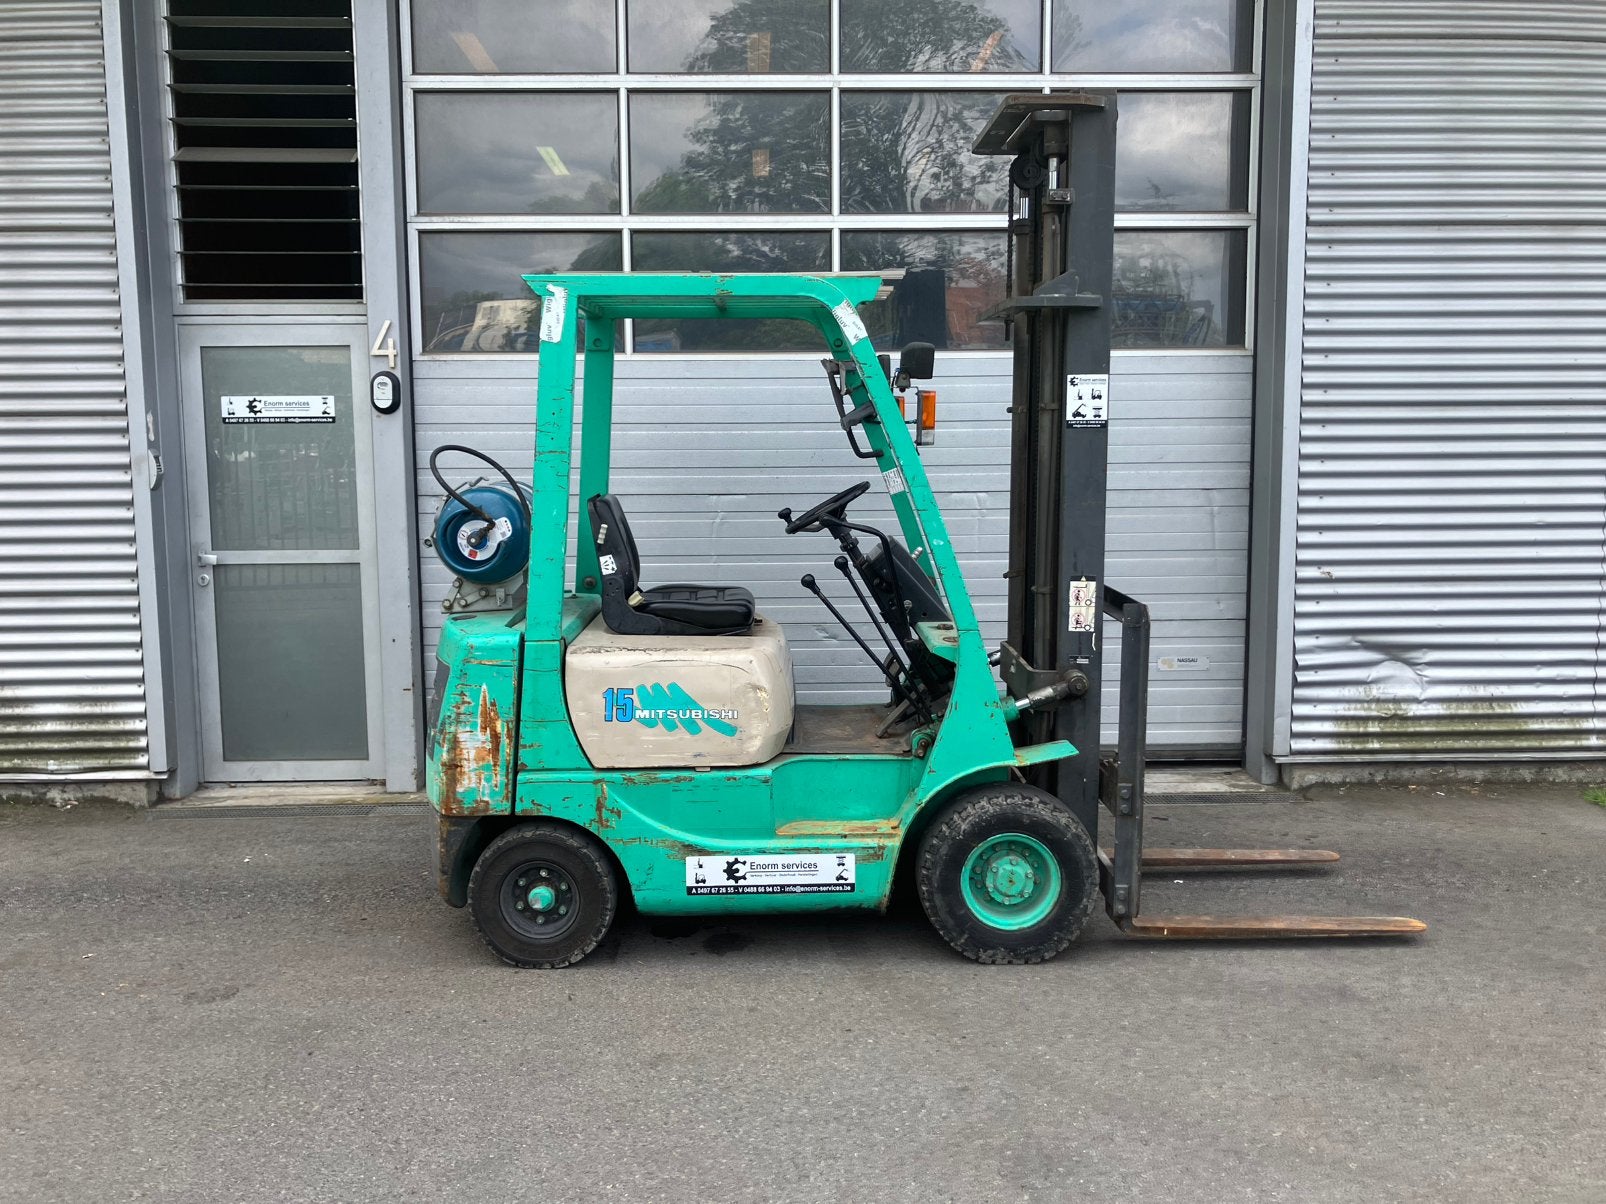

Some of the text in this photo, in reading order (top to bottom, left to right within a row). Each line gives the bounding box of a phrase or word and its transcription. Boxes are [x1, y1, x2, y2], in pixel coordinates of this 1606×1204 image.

[370, 319, 397, 368] 4
[601, 687, 739, 722] 15 MITSUBISHI
[750, 860, 818, 870] Enorm services
[784, 885, 851, 893] info@enorm-services.be
